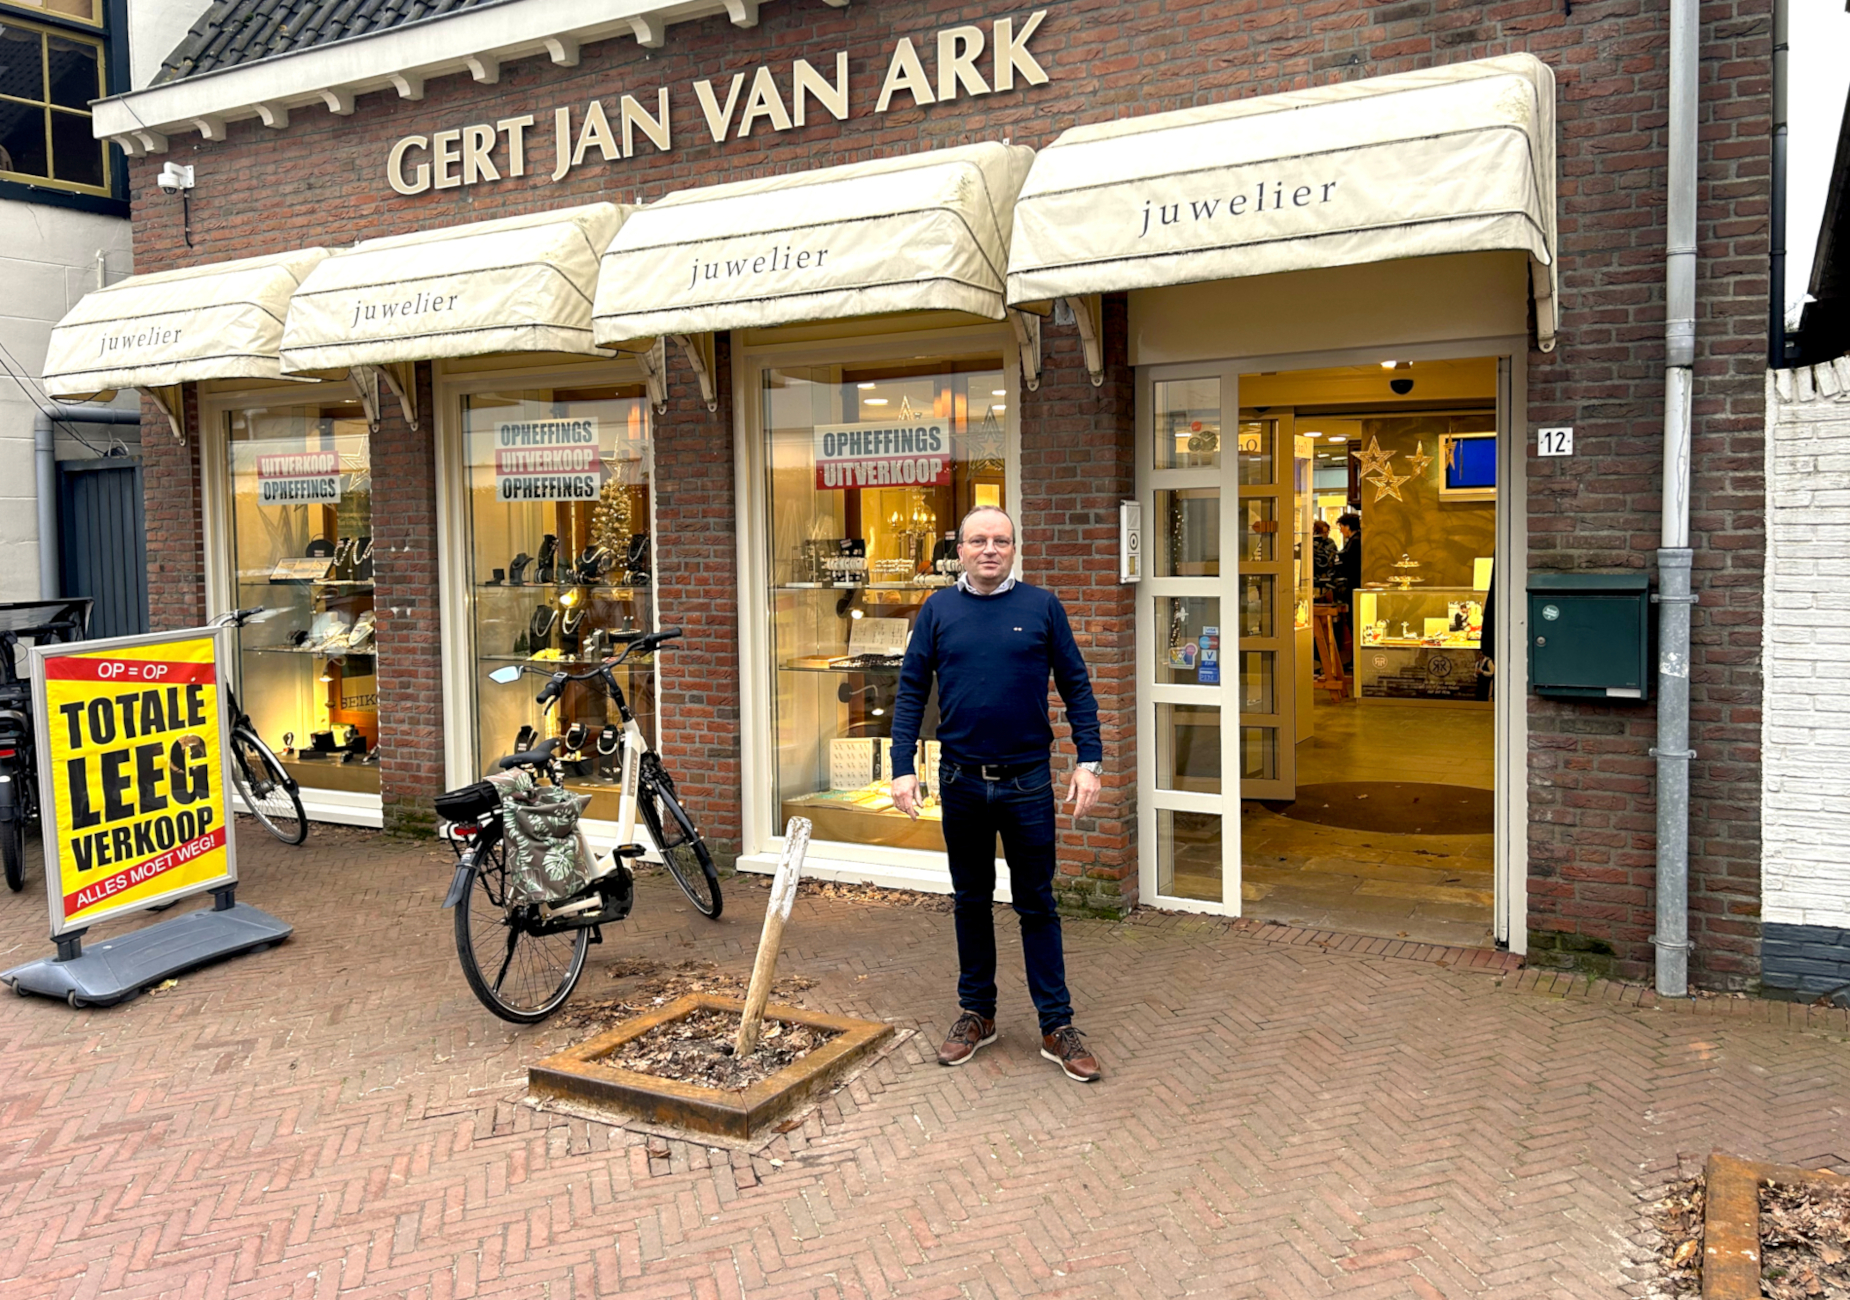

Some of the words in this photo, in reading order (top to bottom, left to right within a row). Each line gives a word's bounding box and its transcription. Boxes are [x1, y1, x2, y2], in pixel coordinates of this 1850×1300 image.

[387, 114, 534, 196] GERT
[551, 87, 671, 182] JAN
[693, 51, 849, 142] VAN
[875, 9, 1050, 112] ARK
[1138, 180, 1338, 239] juwelier
[689, 244, 829, 290] juwelier
[351, 290, 459, 329] juwelier
[99, 326, 183, 357] juwelier
[500, 420, 593, 446] OPHEFFINGS
[823, 426, 942, 457] OPHEFFINGS
[1544, 431, 1566, 453] 12
[261, 454, 335, 477] UITVERKOOP
[501, 448, 594, 473] UITVERKOOP
[823, 458, 942, 487] UITVERKOOP
[264, 478, 336, 500] OPHEFFINGS
[502, 475, 594, 499] OPHEFFINGS
[98, 662, 125, 678] OP
[143, 665, 168, 680] OP
[60, 684, 206, 750] TOTALE
[67, 735, 210, 831] LEEG
[71, 806, 213, 872] VERKOOP
[76, 874, 127, 908] ALLES
[130, 856, 175, 887] MOET
[177, 834, 216, 868] WEG!
